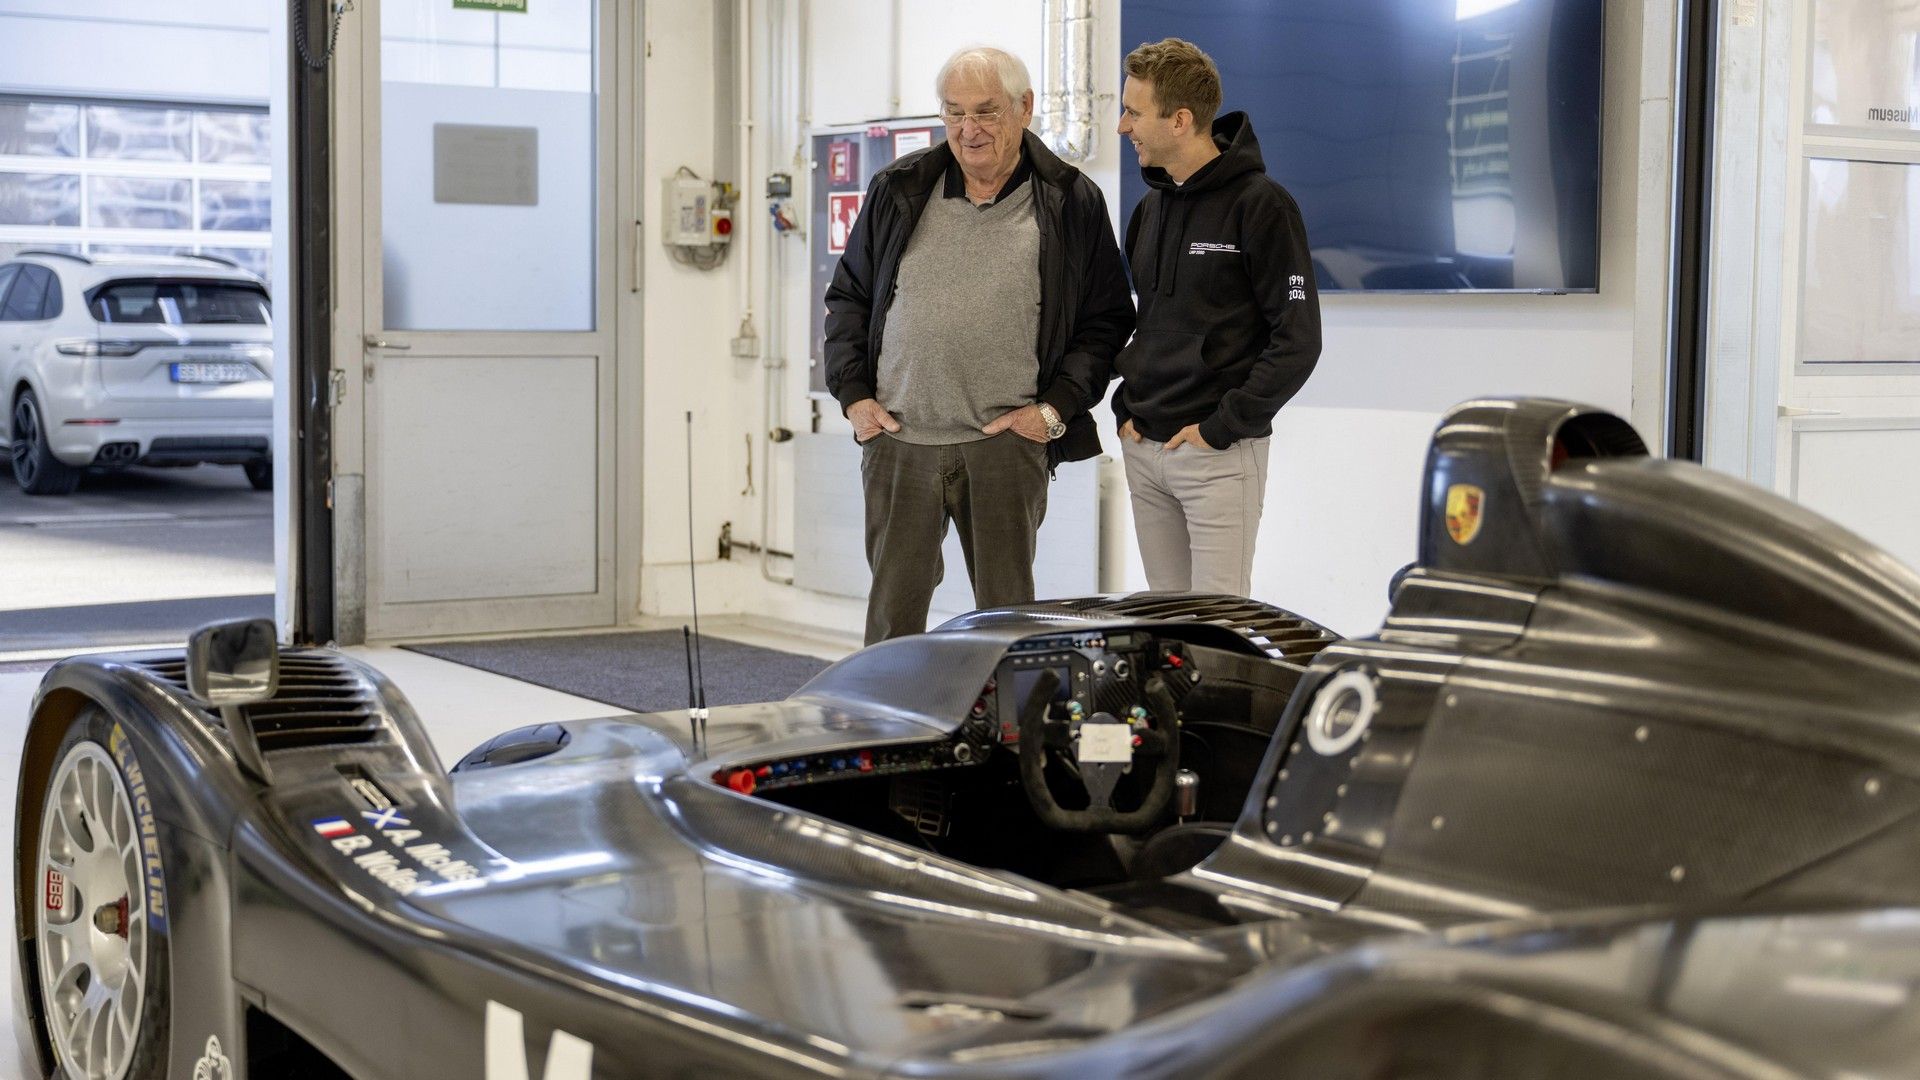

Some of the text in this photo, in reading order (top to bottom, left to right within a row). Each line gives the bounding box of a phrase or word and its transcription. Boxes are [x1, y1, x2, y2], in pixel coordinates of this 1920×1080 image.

[1190, 242, 1236, 250] PORSCHE
[1289, 274, 1305, 286] 1999
[1289, 289, 1306, 301] 2024
[126, 760, 164, 917] MICHELIN
[48, 870, 63, 908] BBS
